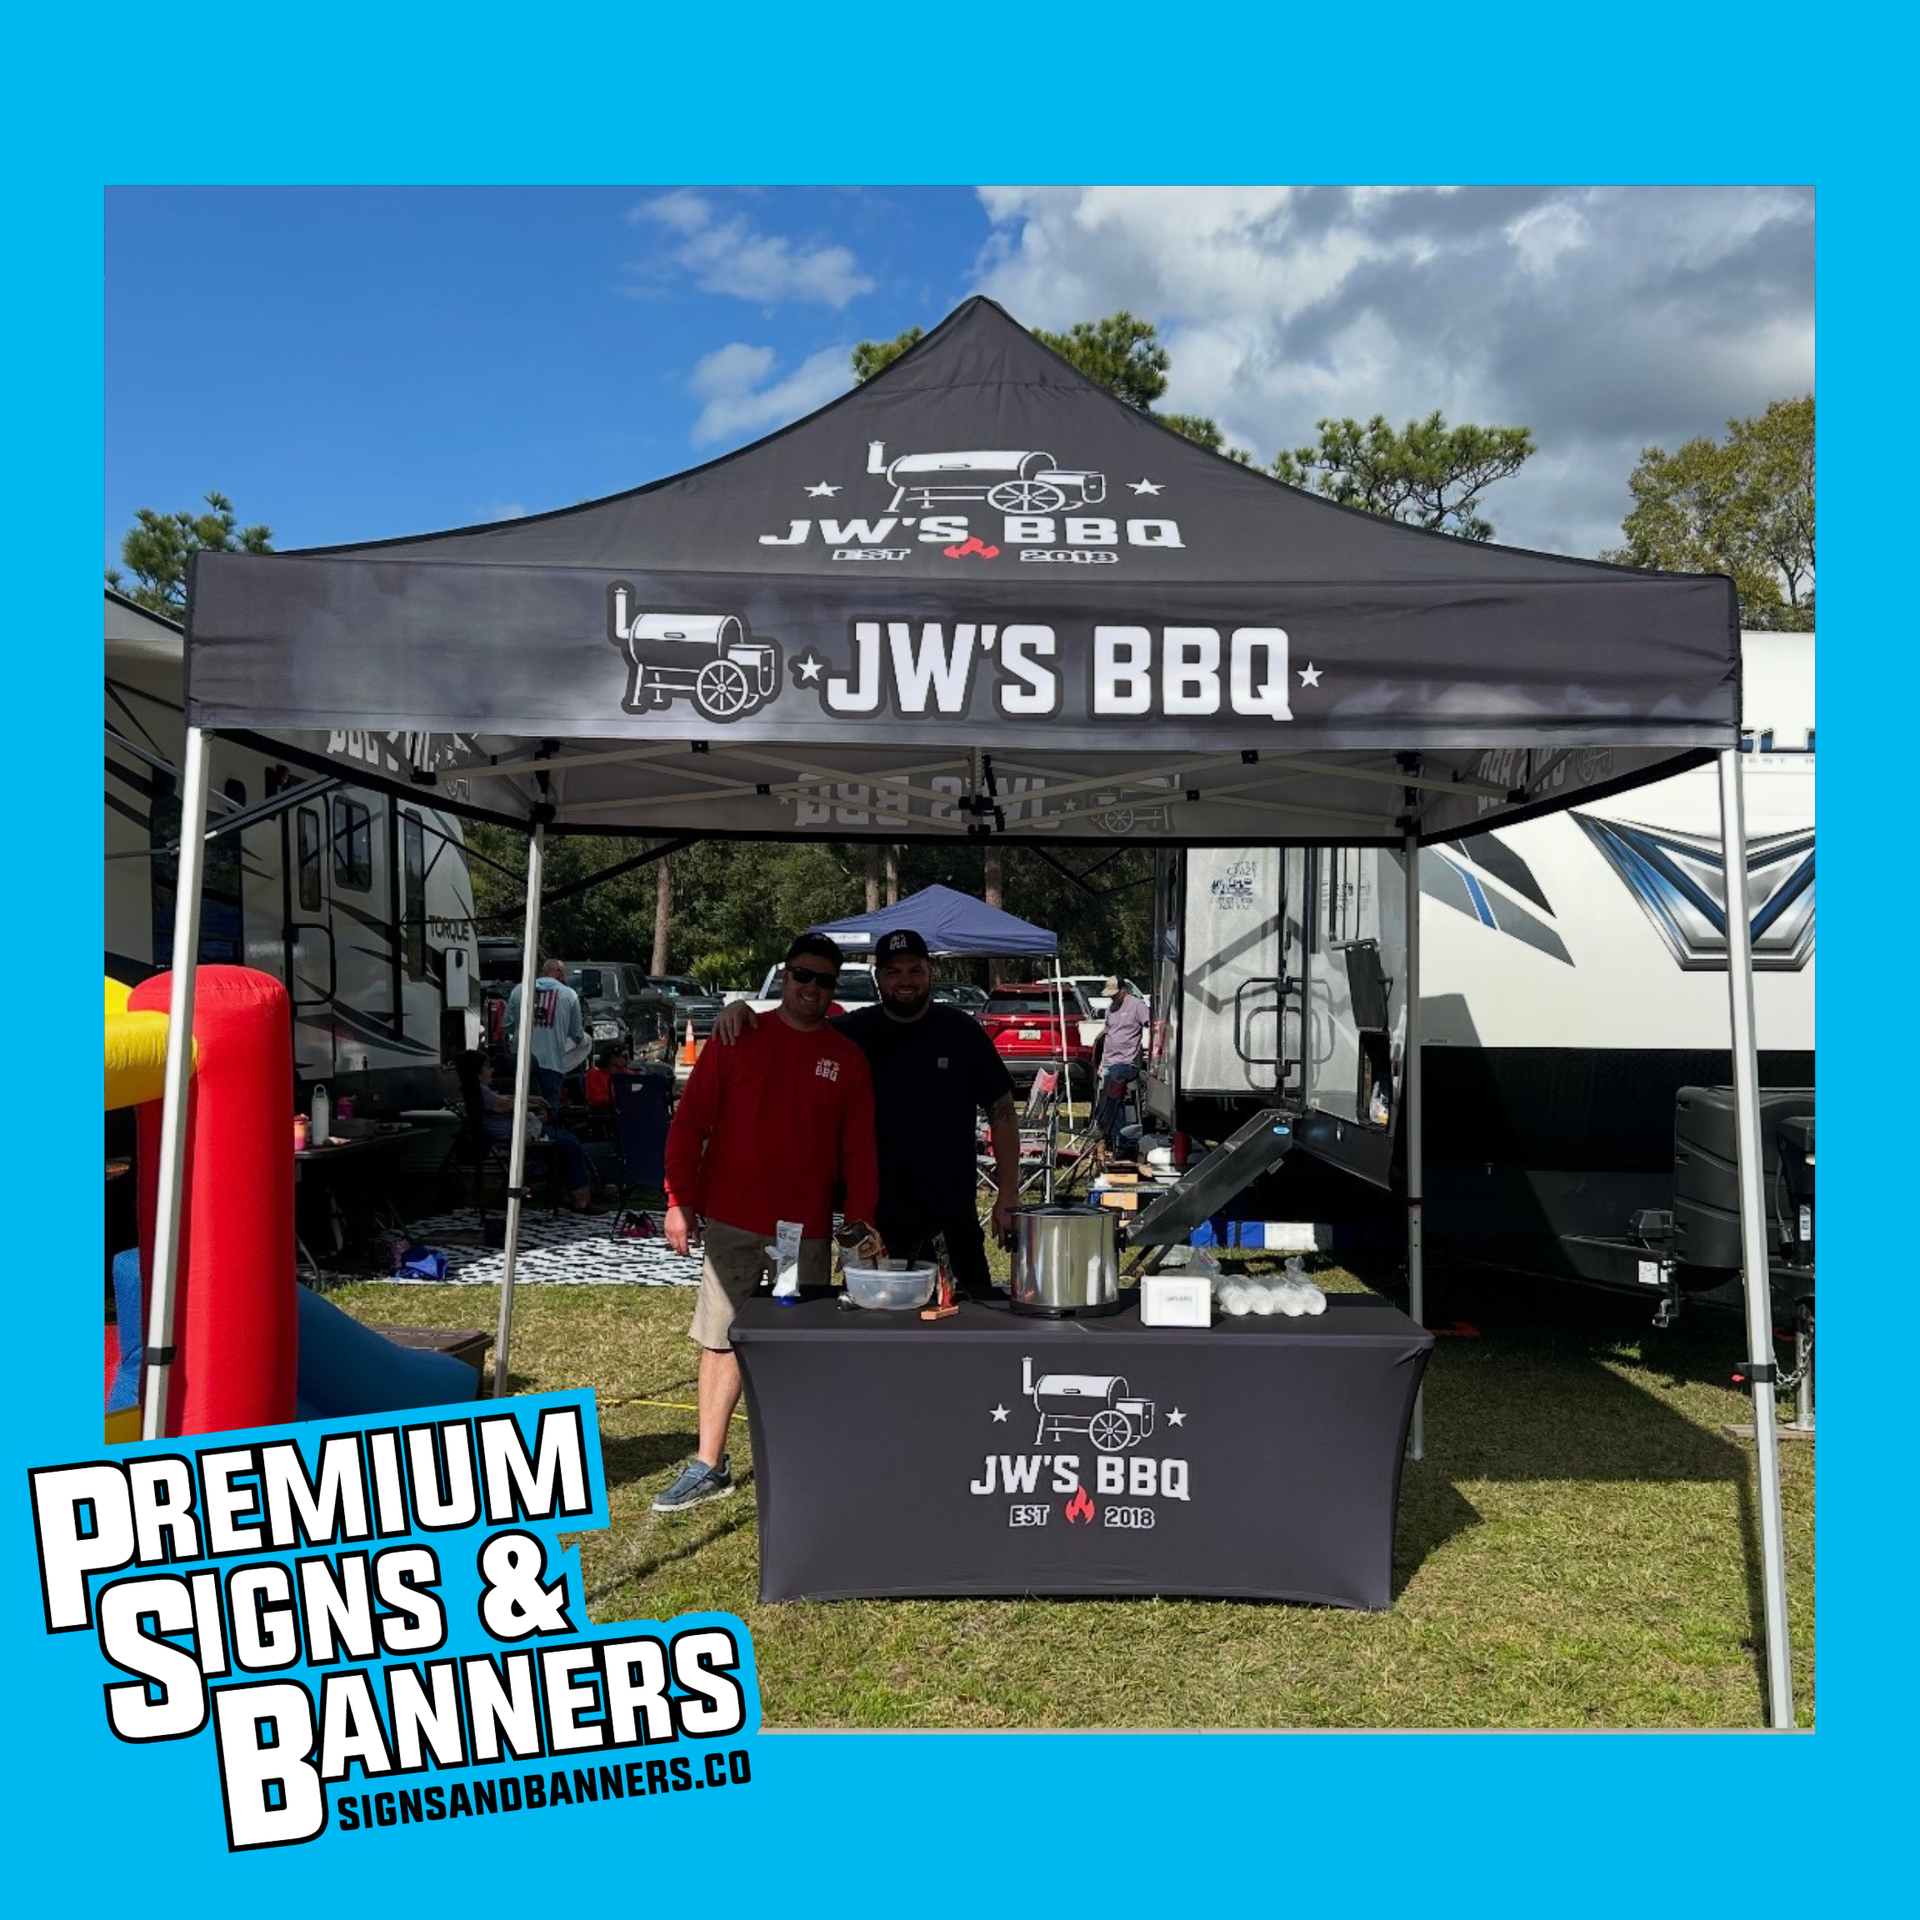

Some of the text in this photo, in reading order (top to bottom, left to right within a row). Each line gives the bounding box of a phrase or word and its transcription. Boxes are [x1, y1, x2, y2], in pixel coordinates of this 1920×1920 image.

[757, 516, 1187, 549] JW'S BBQ
[832, 549, 1119, 564] EST 2018
[826, 622, 1294, 722] JW'S BBQ
[428, 915, 470, 944] TORQUE
[970, 1455, 1191, 1501] JW'S BBQ
[1009, 1504, 1155, 1529] EST 2018
